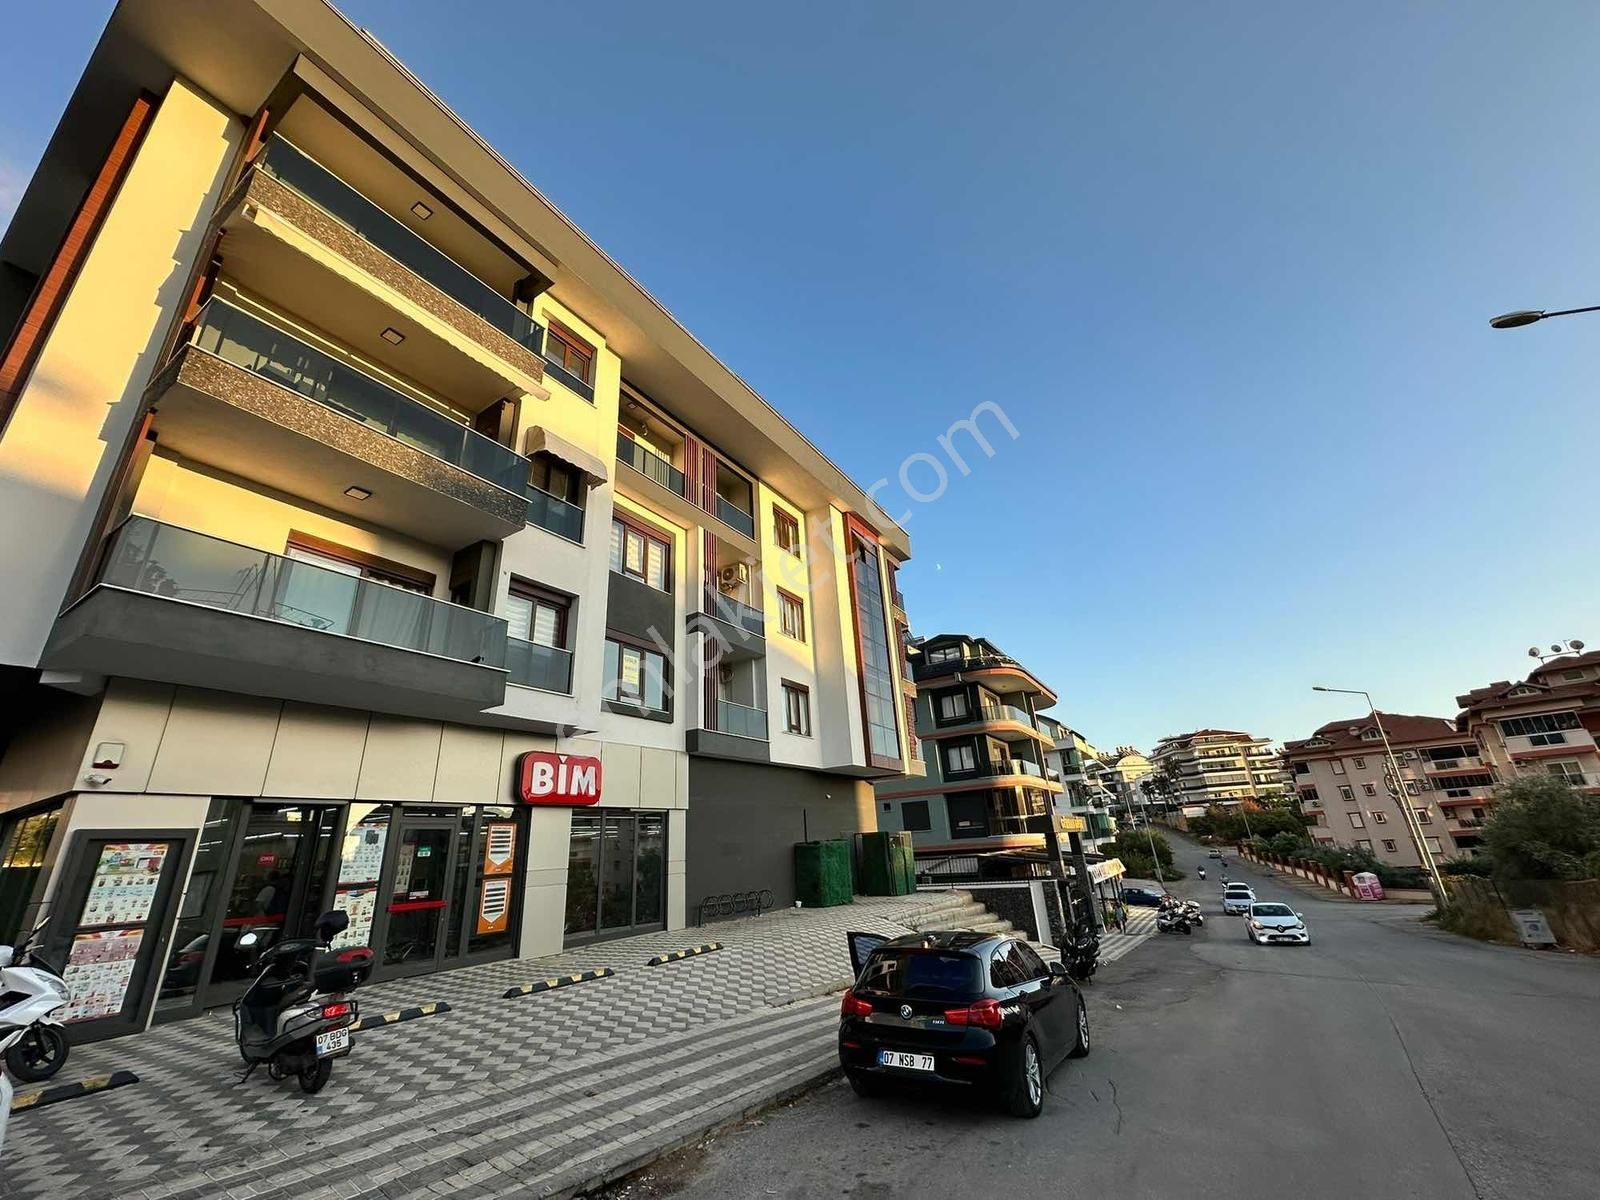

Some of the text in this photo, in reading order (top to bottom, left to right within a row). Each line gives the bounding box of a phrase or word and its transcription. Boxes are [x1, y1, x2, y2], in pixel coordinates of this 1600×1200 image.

[530, 755, 596, 796] BİM
[318, 1034, 328, 1044] 07
[326, 1039, 342, 1050] 435
[884, 1052, 933, 1069] 07 NSB 77
